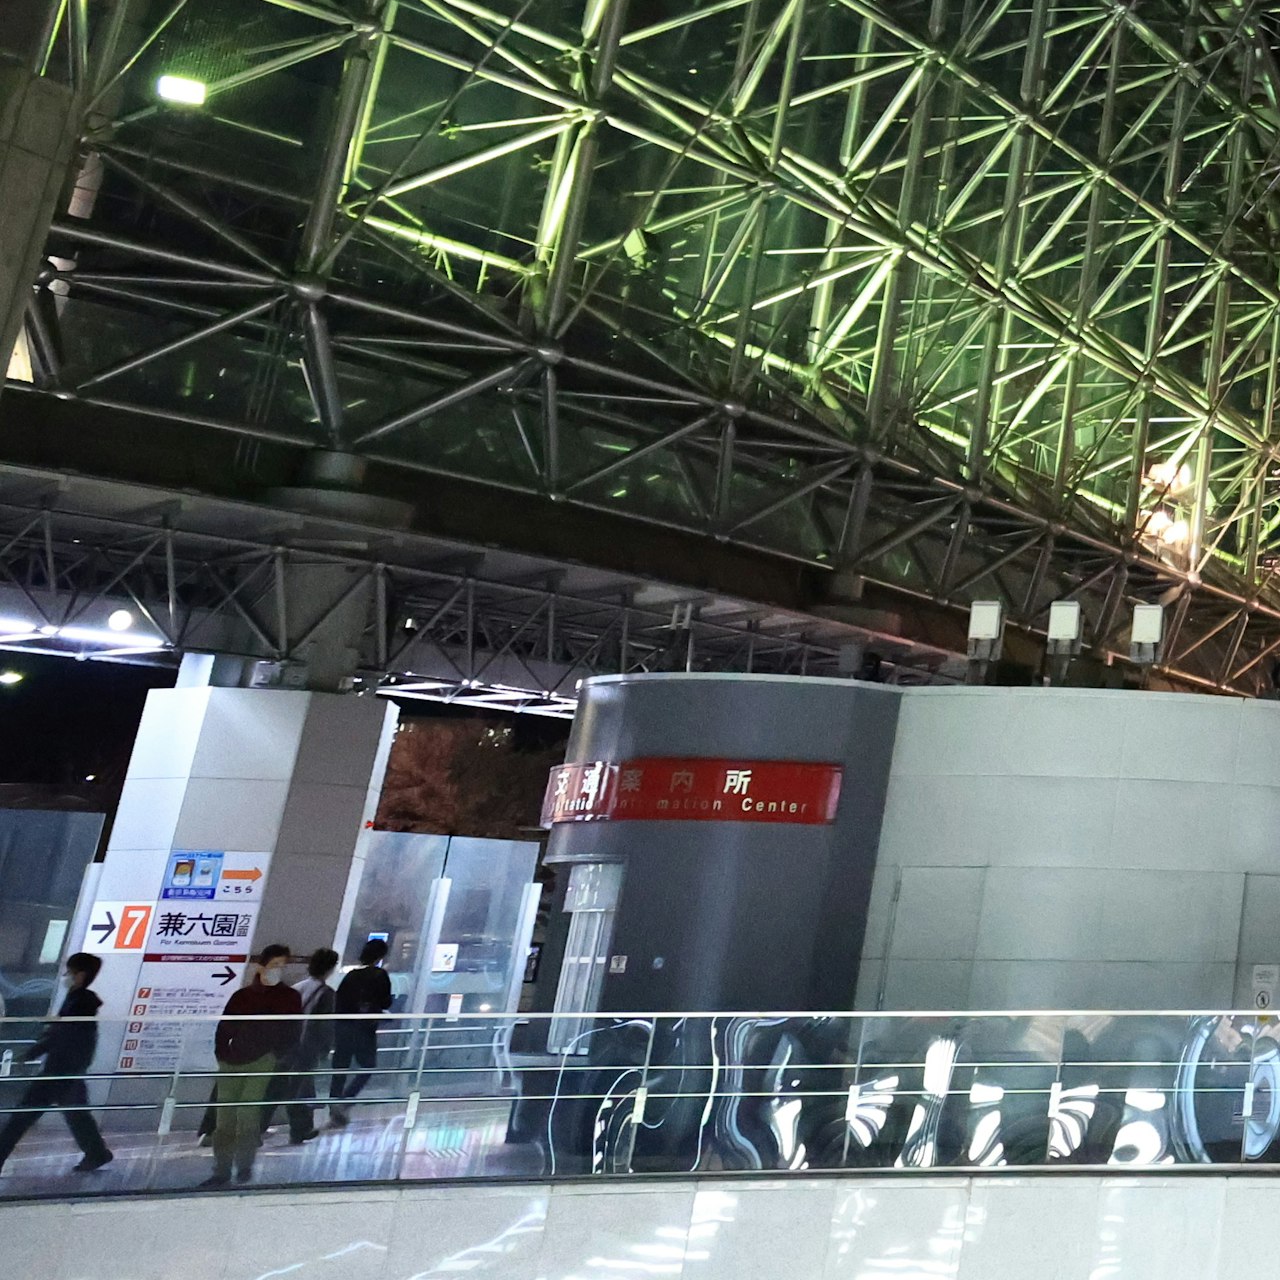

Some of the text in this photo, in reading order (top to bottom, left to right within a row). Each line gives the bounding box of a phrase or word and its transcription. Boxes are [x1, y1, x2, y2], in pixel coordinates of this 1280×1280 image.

[741, 797, 808, 814] Center
[222, 885, 253, 894] こちら
[123, 910, 147, 946] 7
[156, 912, 239, 937] 兼六園
